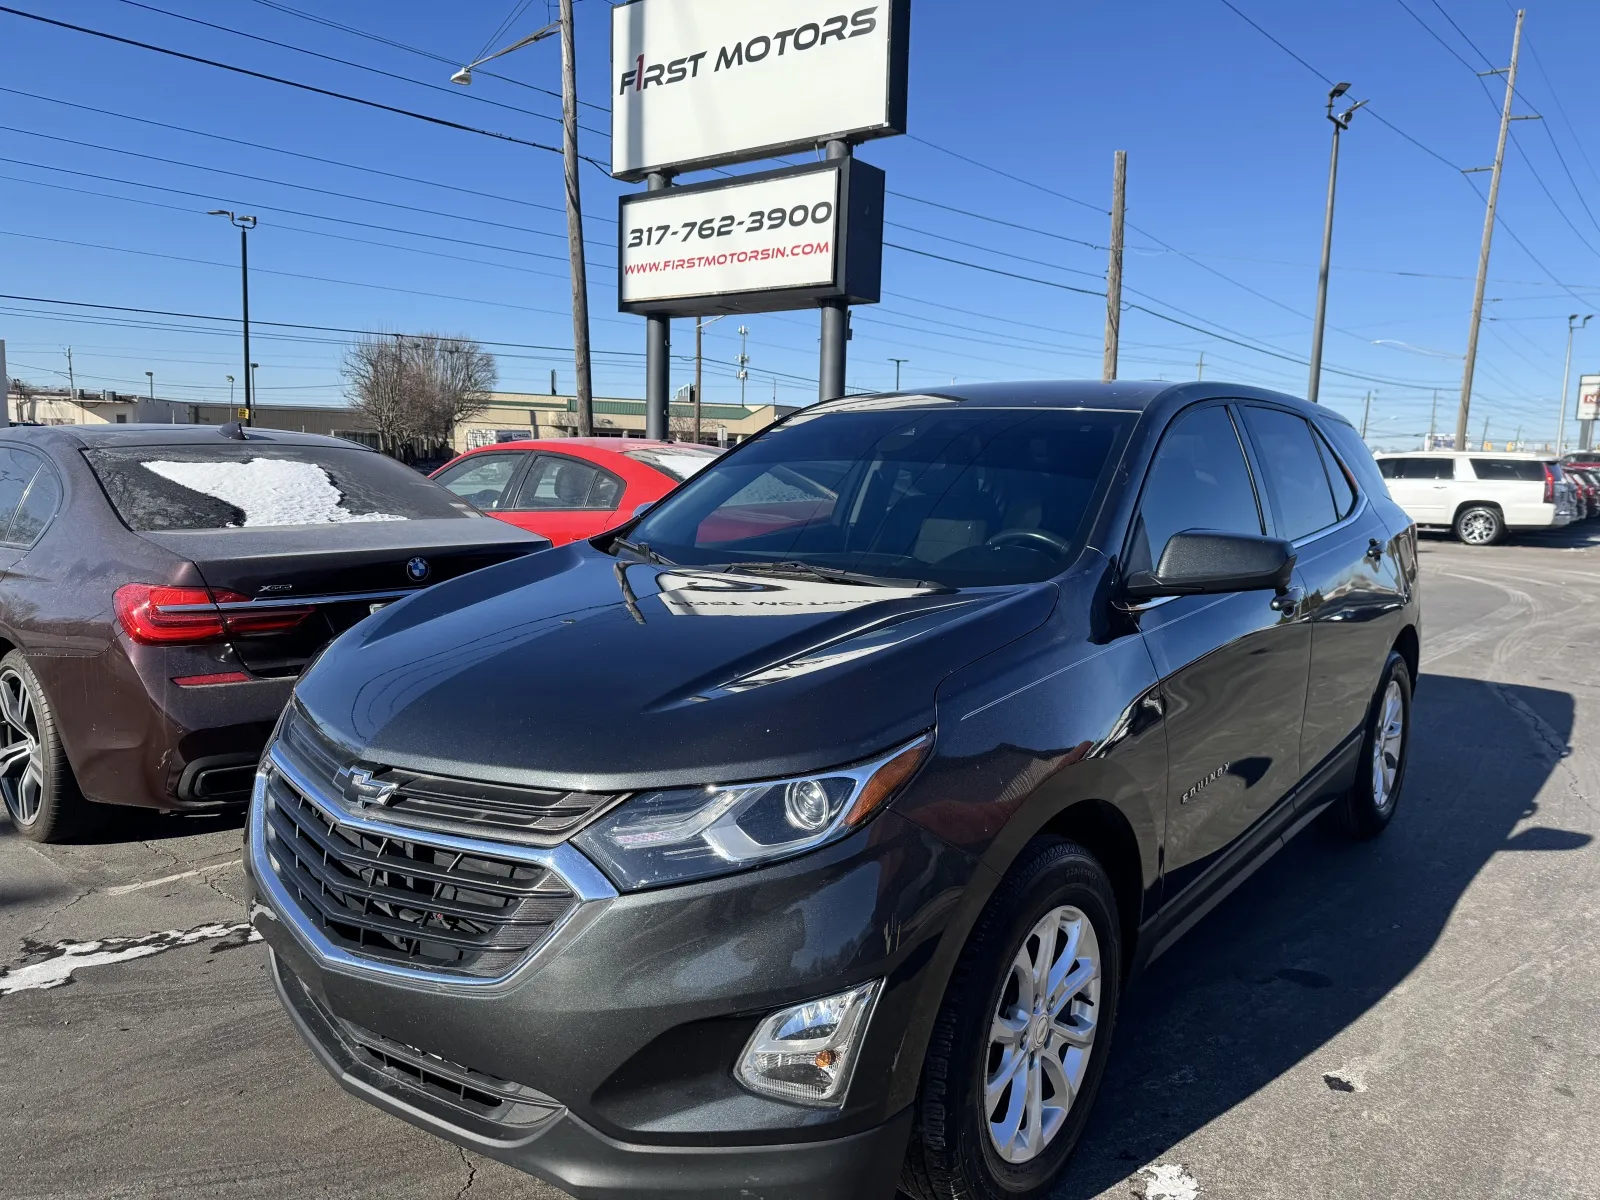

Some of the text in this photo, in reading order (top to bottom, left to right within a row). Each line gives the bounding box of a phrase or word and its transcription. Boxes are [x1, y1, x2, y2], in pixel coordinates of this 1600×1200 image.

[714, 6, 878, 72] MOTORS
[627, 201, 832, 248] 317-762-3900
[624, 241, 829, 275] WWW.FIRSTMOTORSIN.COM
[1181, 761, 1230, 804] EQUINOX
